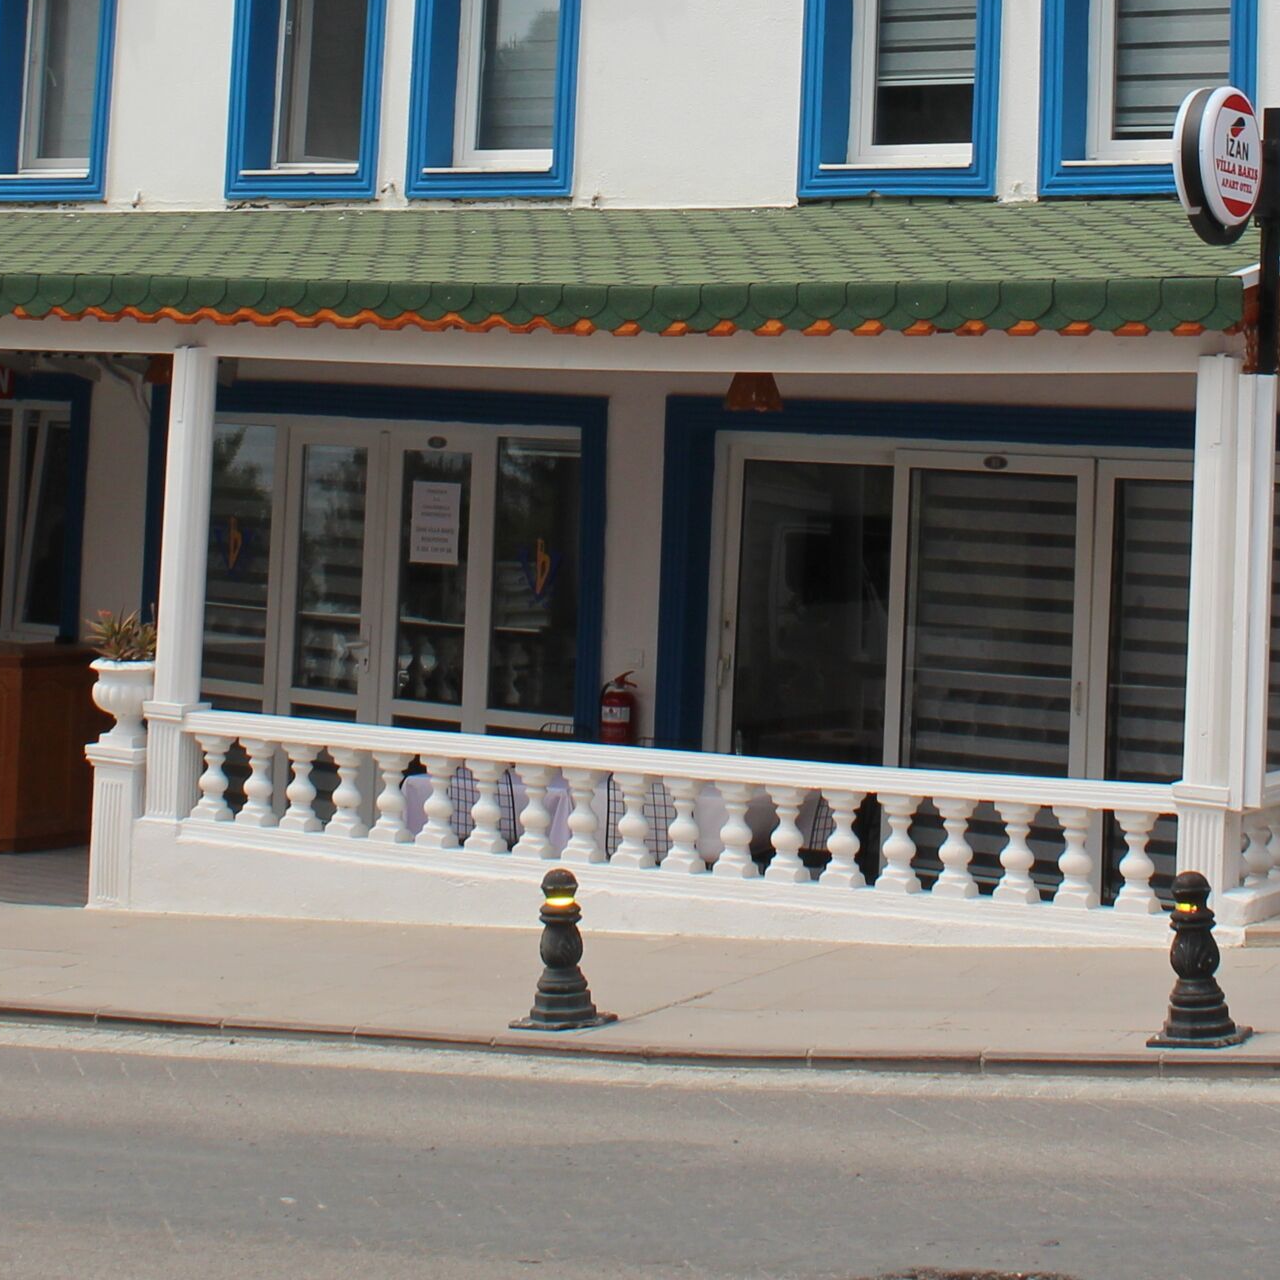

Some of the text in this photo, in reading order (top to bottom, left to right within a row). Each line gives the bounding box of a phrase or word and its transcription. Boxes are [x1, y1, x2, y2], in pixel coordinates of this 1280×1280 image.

[1238, 164, 1258, 184] BAKIŞ
[1222, 179, 1253, 195] APART OTEL
